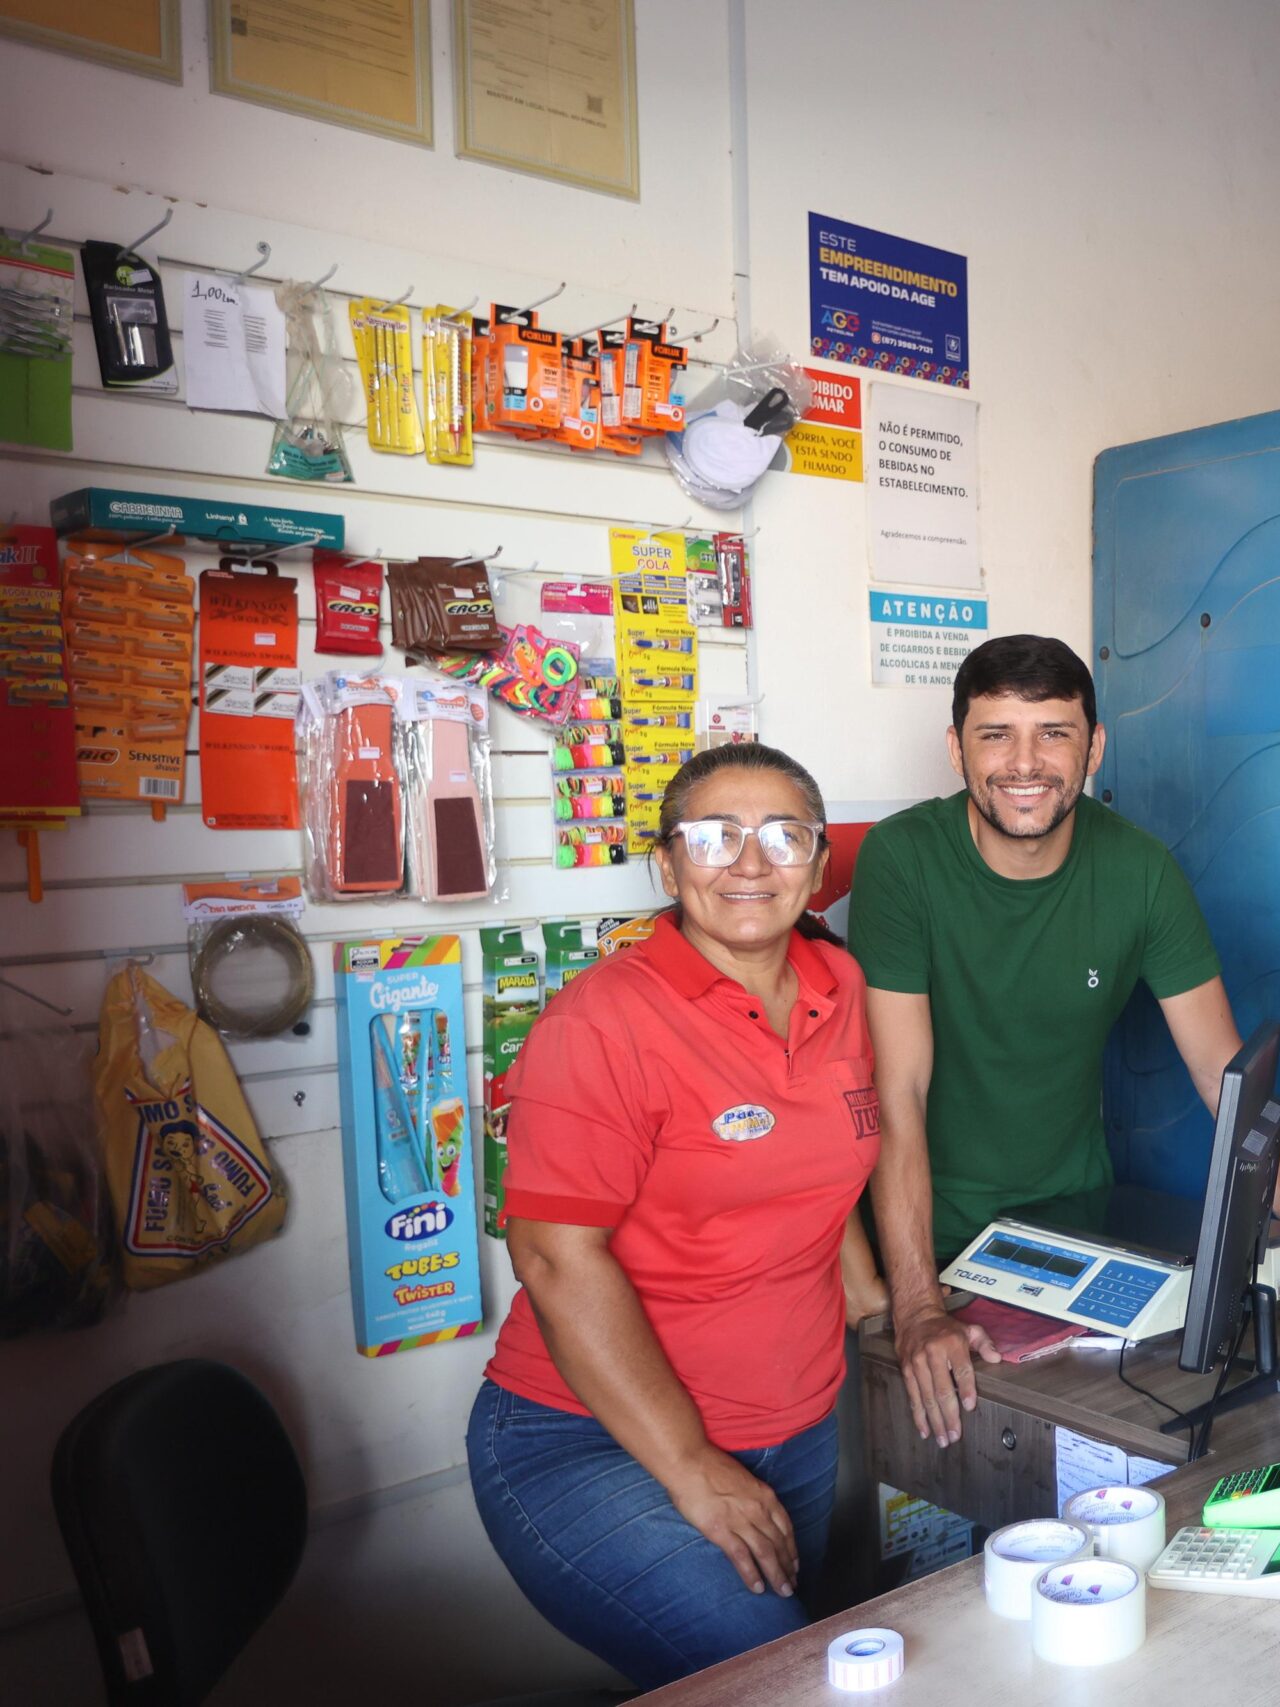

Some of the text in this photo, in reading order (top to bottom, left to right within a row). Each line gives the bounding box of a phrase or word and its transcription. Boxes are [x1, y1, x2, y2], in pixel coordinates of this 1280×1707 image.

[820, 231, 856, 252] ESTE
[819, 247, 958, 297] EMPREENDIMENTO
[820, 267, 936, 308] TEM APOIO DA AGE
[879, 421, 964, 447] NÃO É PERMITIDO,
[820, 450, 853, 463] SENDO
[878, 441, 952, 461] O CONSUMO DE
[803, 460, 846, 475] FILMADO
[879, 459, 935, 476] BEBIDAS NO
[879, 477, 969, 498] ESTABELECIMENTO.
[880, 530, 922, 541] Agradecemos
[632, 546, 672, 558] SUPER
[638, 559, 670, 570] COLA
[448, 601, 493, 614] EROS
[882, 600, 974, 624] ATENÇÃO
[628, 629, 645, 637] Super
[894, 628, 932, 639] PROIBIDA
[935, 631, 940, 640] A
[942, 632, 969, 641] VENDA
[880, 644, 890, 652] DE
[892, 644, 934, 654] CIGARROS
[936, 646, 941, 654] E
[629, 667, 646, 675] Super
[932, 662, 938, 670] A
[906, 674, 916, 684] DE
[918, 676, 928, 684] 18
[624, 707, 641, 715] Super
[626, 745, 643, 753] Super
[128, 750, 181, 765] SENSITIVE
[370, 975, 439, 1012] Gigante
[391, 1202, 446, 1238] Fini
[385, 1252, 460, 1280] TUBES
[954, 1268, 997, 1286] TOLEDO
